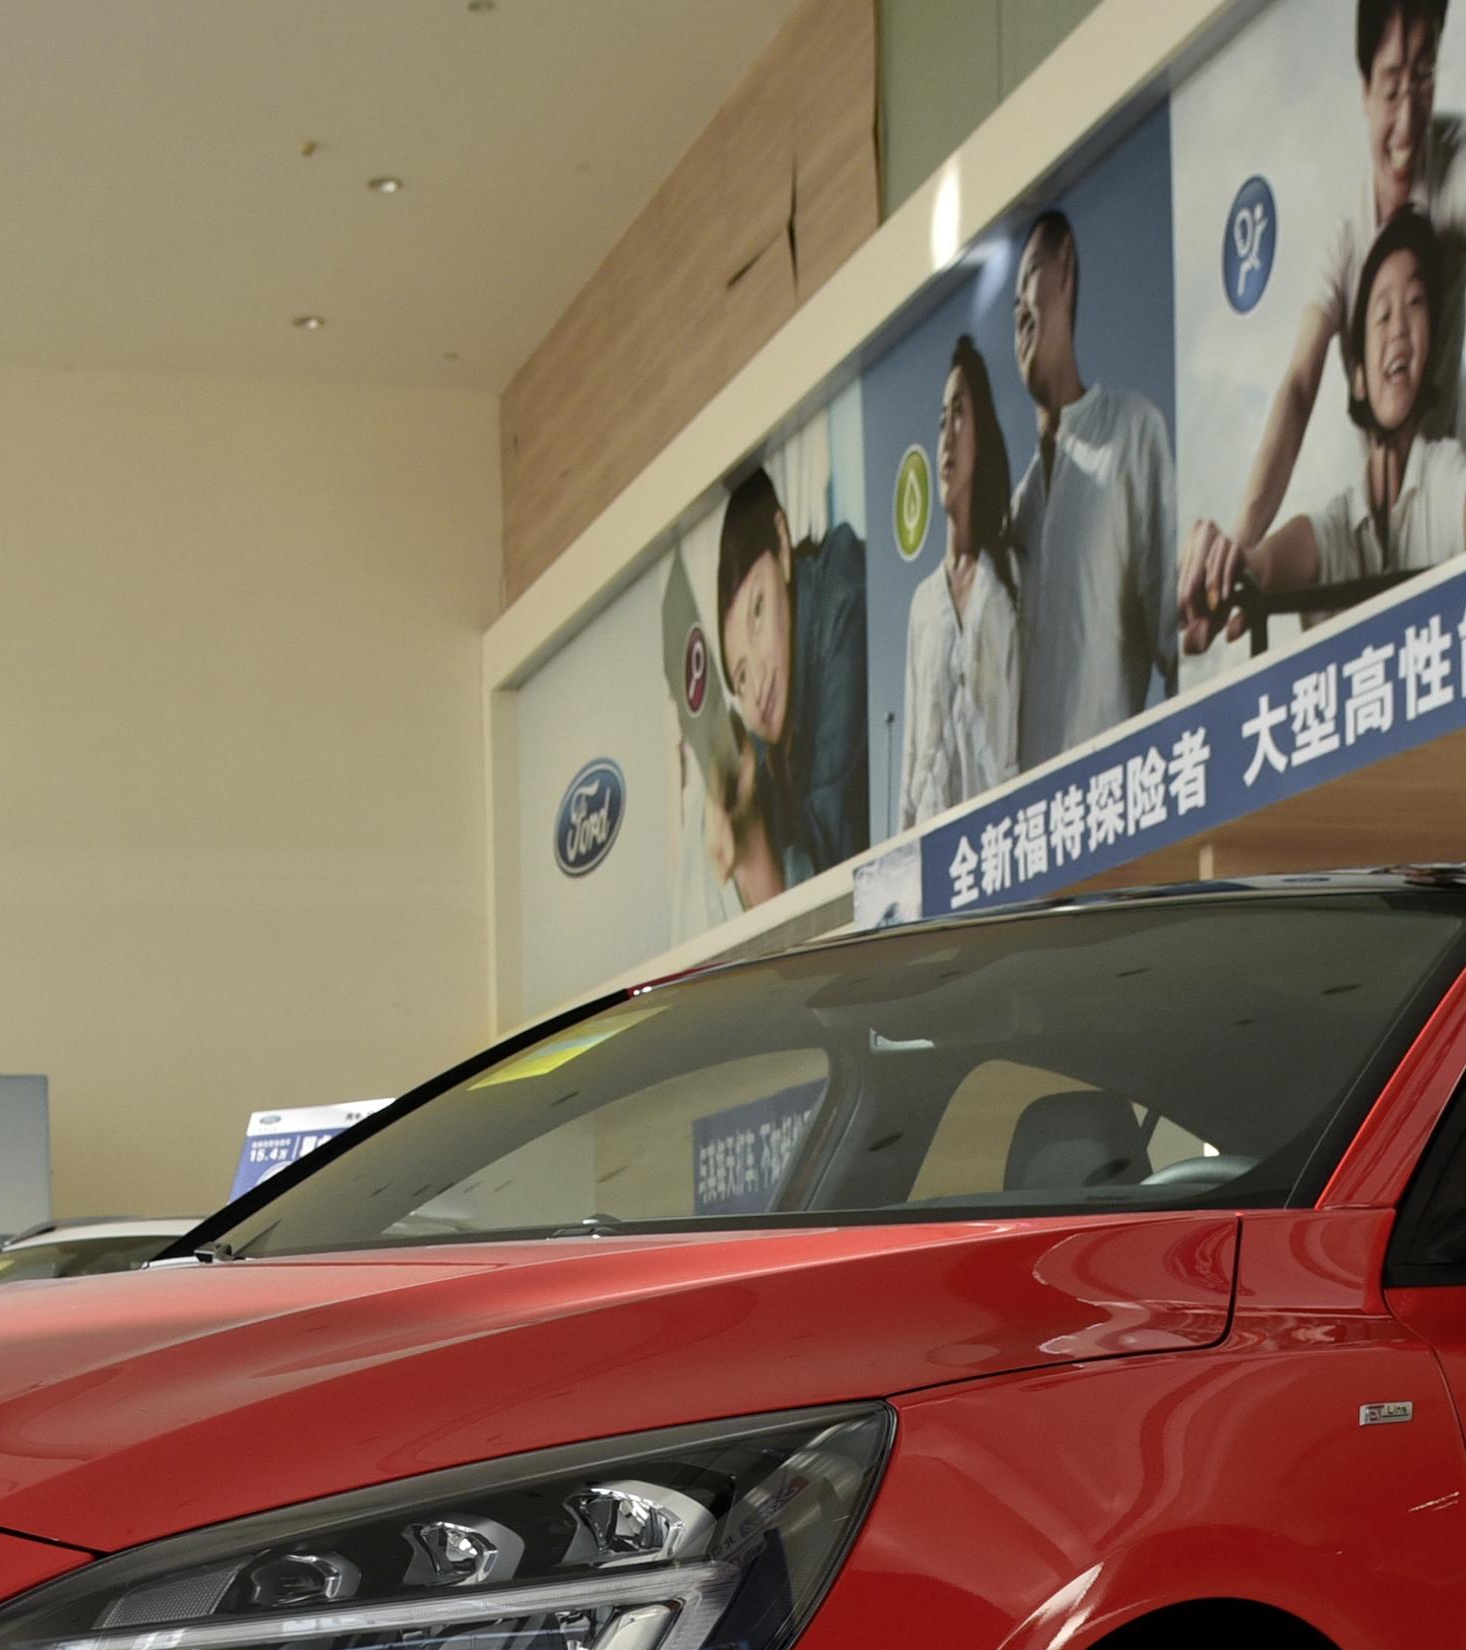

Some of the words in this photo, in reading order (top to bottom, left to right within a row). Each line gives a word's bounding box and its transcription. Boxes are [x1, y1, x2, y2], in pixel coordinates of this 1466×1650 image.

[566, 780, 611, 861] Ford
[948, 728, 1213, 909] 全新福特探险者
